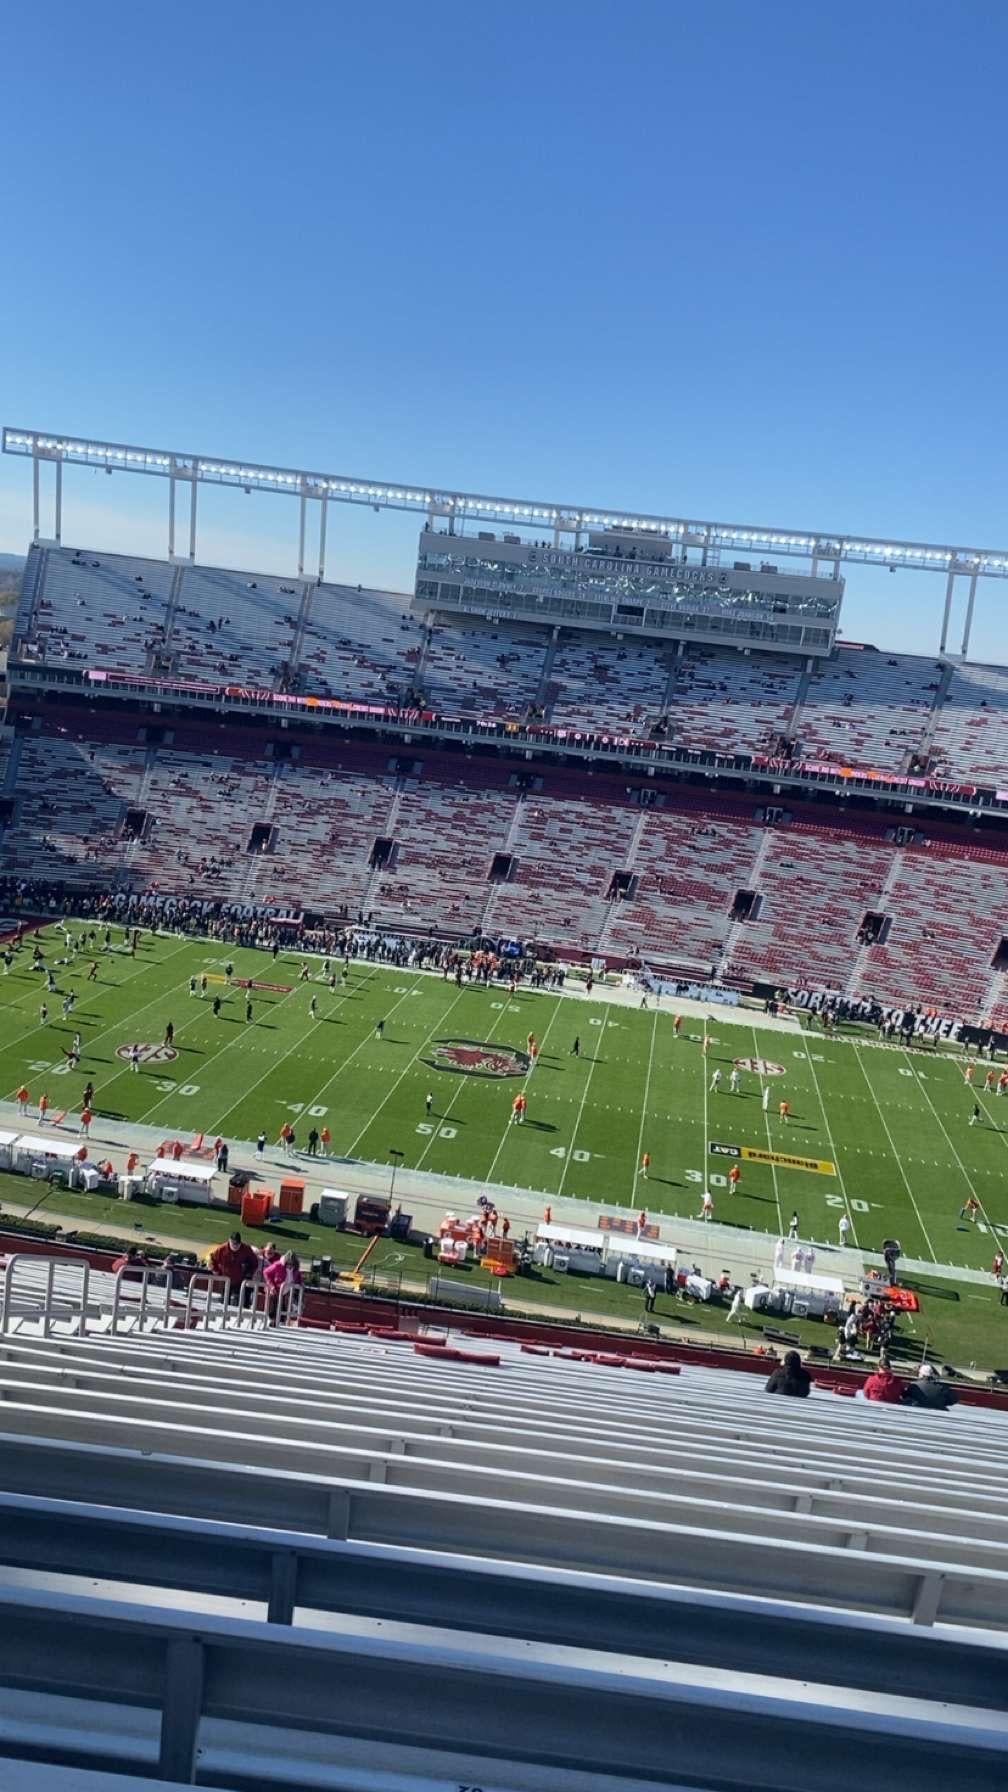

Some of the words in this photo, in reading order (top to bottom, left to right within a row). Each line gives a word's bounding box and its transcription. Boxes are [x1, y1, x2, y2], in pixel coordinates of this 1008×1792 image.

[543, 553, 578, 567] SOUTH
[584, 558, 640, 575] CAROLINA
[646, 566, 714, 583] GAMECOCKS
[792, 1050, 825, 1062] 20
[156, 1080, 201, 1096] 30
[286, 1102, 329, 1117] 40
[416, 1121, 459, 1139] 50
[549, 1146, 592, 1163] 40
[712, 1144, 740, 1156] CAT
[684, 1168, 727, 1188] 30
[824, 1193, 871, 1213] 20
